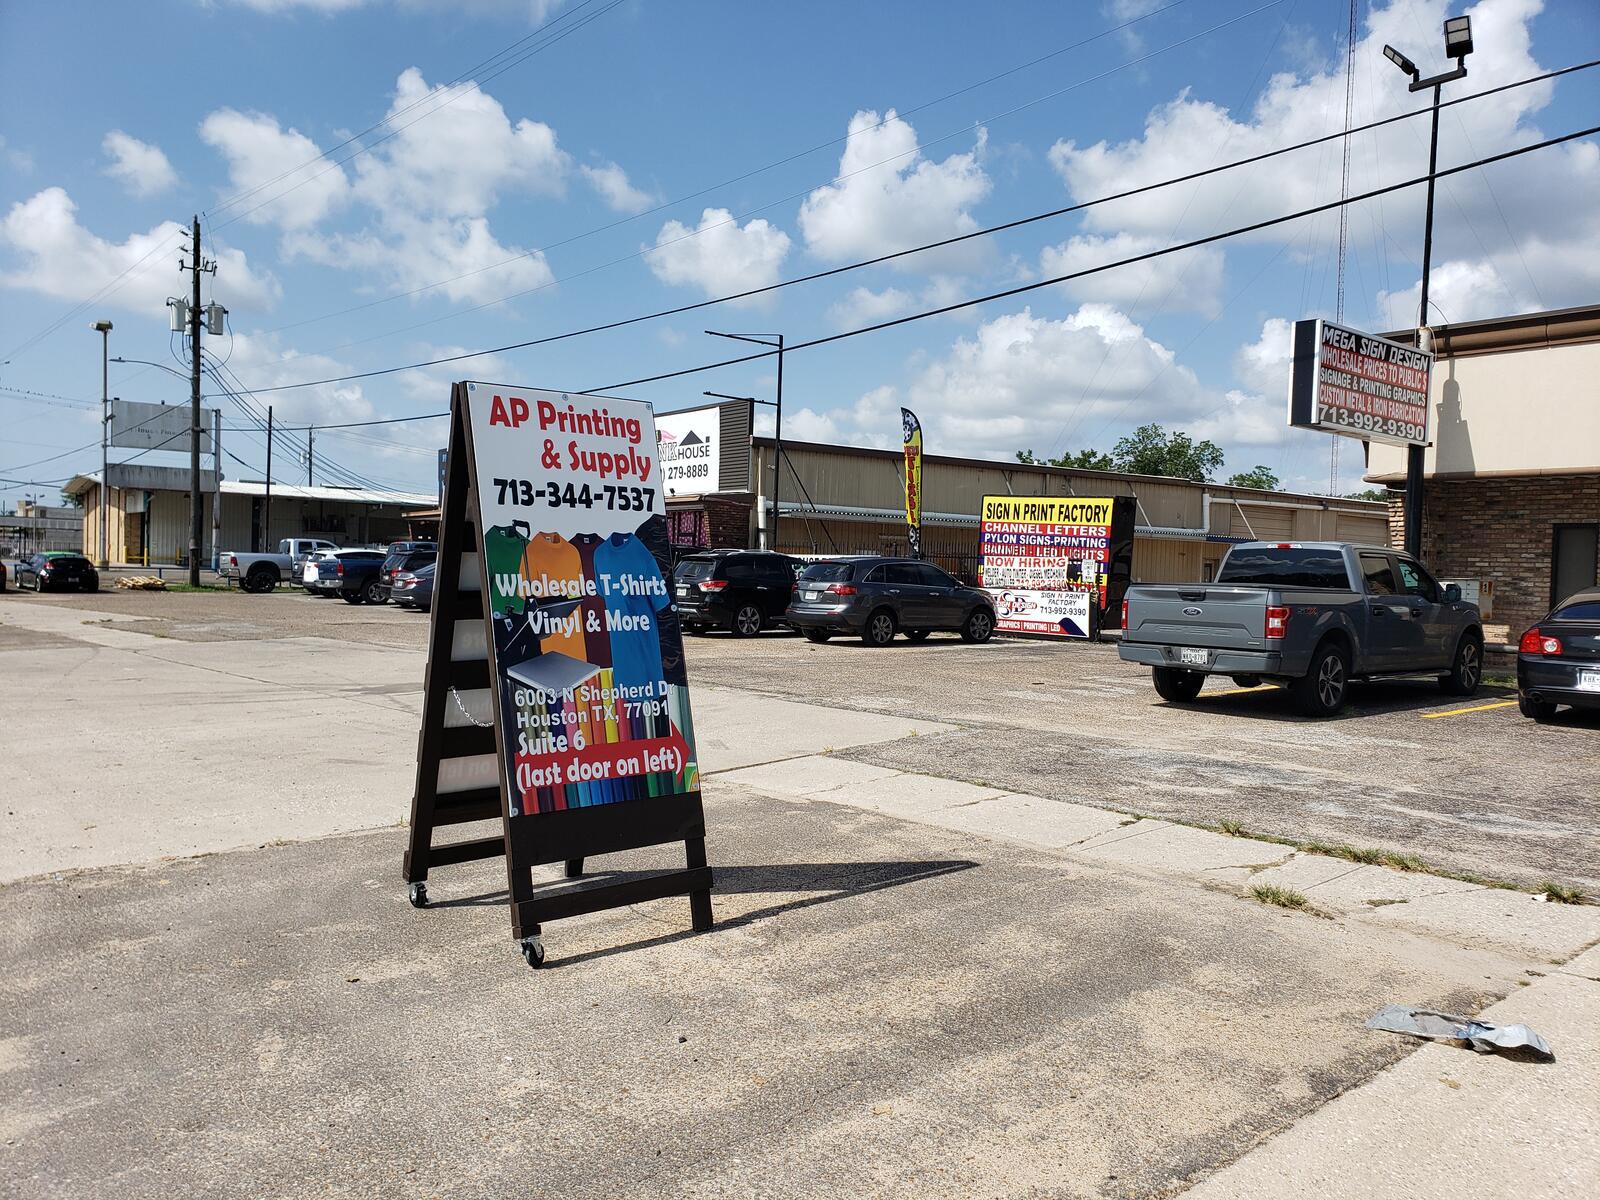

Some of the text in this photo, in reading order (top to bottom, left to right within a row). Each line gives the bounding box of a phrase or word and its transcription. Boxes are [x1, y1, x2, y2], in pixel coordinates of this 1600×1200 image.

[1323, 326, 1428, 370] MEGA SIGN DESIGN
[1322, 346, 1361, 374] WHOLESALE
[1364, 357, 1387, 380] PRICES
[1388, 364, 1397, 383] TO
[1399, 368, 1420, 388] PUBLIC
[1320, 368, 1425, 406] SIGNAGE & PRINTING GRAPHICS
[1320, 385, 1425, 424] CUSTOM METAL & IRON FABRICATION
[490, 395, 641, 444] AP Printing
[1319, 404, 1424, 441] 713-992-9390
[541, 439, 562, 469] &
[568, 440, 651, 481] Supply
[668, 464, 708, 480] 279-8889
[493, 478, 655, 512] 713-344-7537
[986, 502, 1109, 523] SIGN N PRINT FACTORY
[984, 534, 1107, 548] PYLON SIGNS-PRINTING
[985, 522, 1106, 537] CHANNEL LETTERS
[984, 545, 1026, 556] BANNER
[1036, 547, 1058, 557] LED
[1062, 548, 1104, 560] LIGHTS
[986, 557, 1014, 567] NOW
[1019, 557, 1066, 567] HIRING
[495, 573, 666, 597] Wholesale T-Shirts
[528, 609, 650, 638] Vinyl & More
[1040, 607, 1086, 616] 713-992-9390
[1024, 622, 1047, 631] PRINTING
[1050, 623, 1060, 632] LED
[514, 680, 675, 707] 6003 N Shepherd Dr
[516, 700, 669, 729] Houston TX, 77091
[518, 730, 586, 757] Suite 6
[516, 747, 682, 794] (last door on left)
